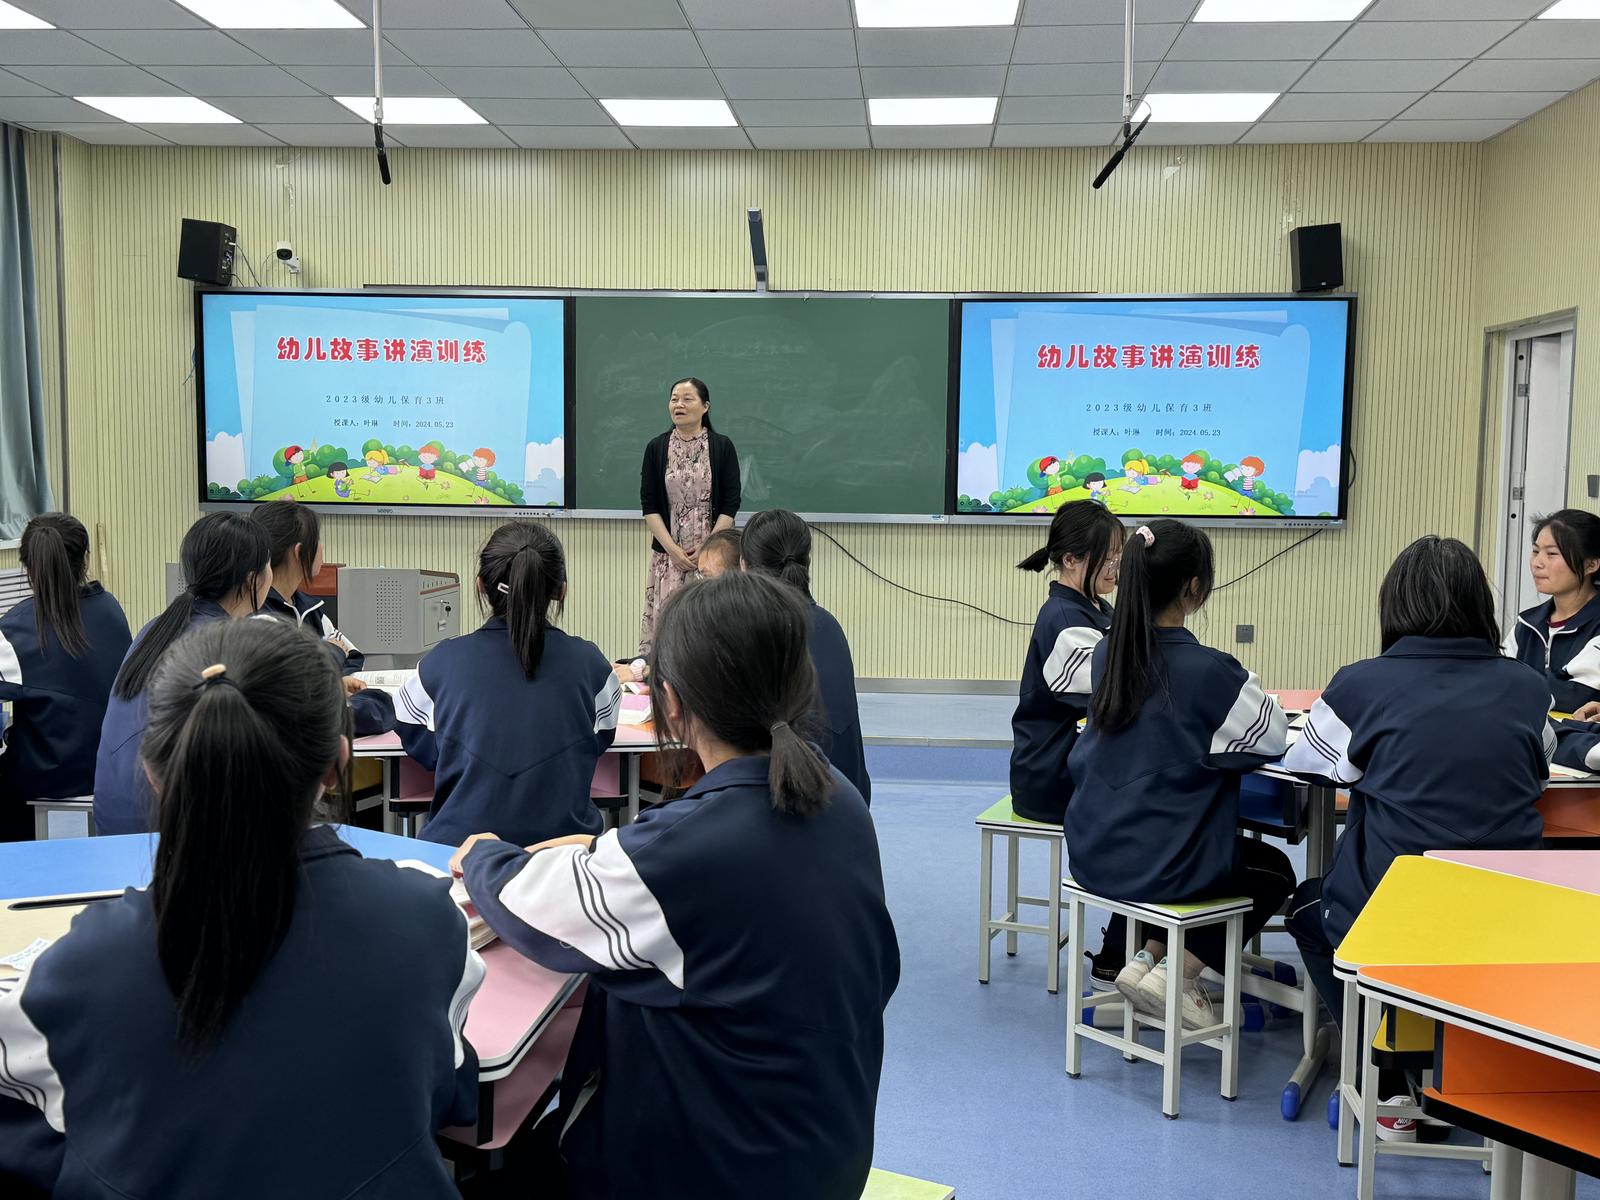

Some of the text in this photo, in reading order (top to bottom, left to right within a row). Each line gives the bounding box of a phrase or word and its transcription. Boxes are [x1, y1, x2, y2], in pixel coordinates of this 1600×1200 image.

[276, 336, 488, 363] 幼儿故事讲演训练
[1036, 344, 1261, 369] 幼儿故事讲演训练
[325, 395, 445, 405] 2023级幼儿保育3班
[1085, 402, 1212, 413] 2023级幼儿保育3班
